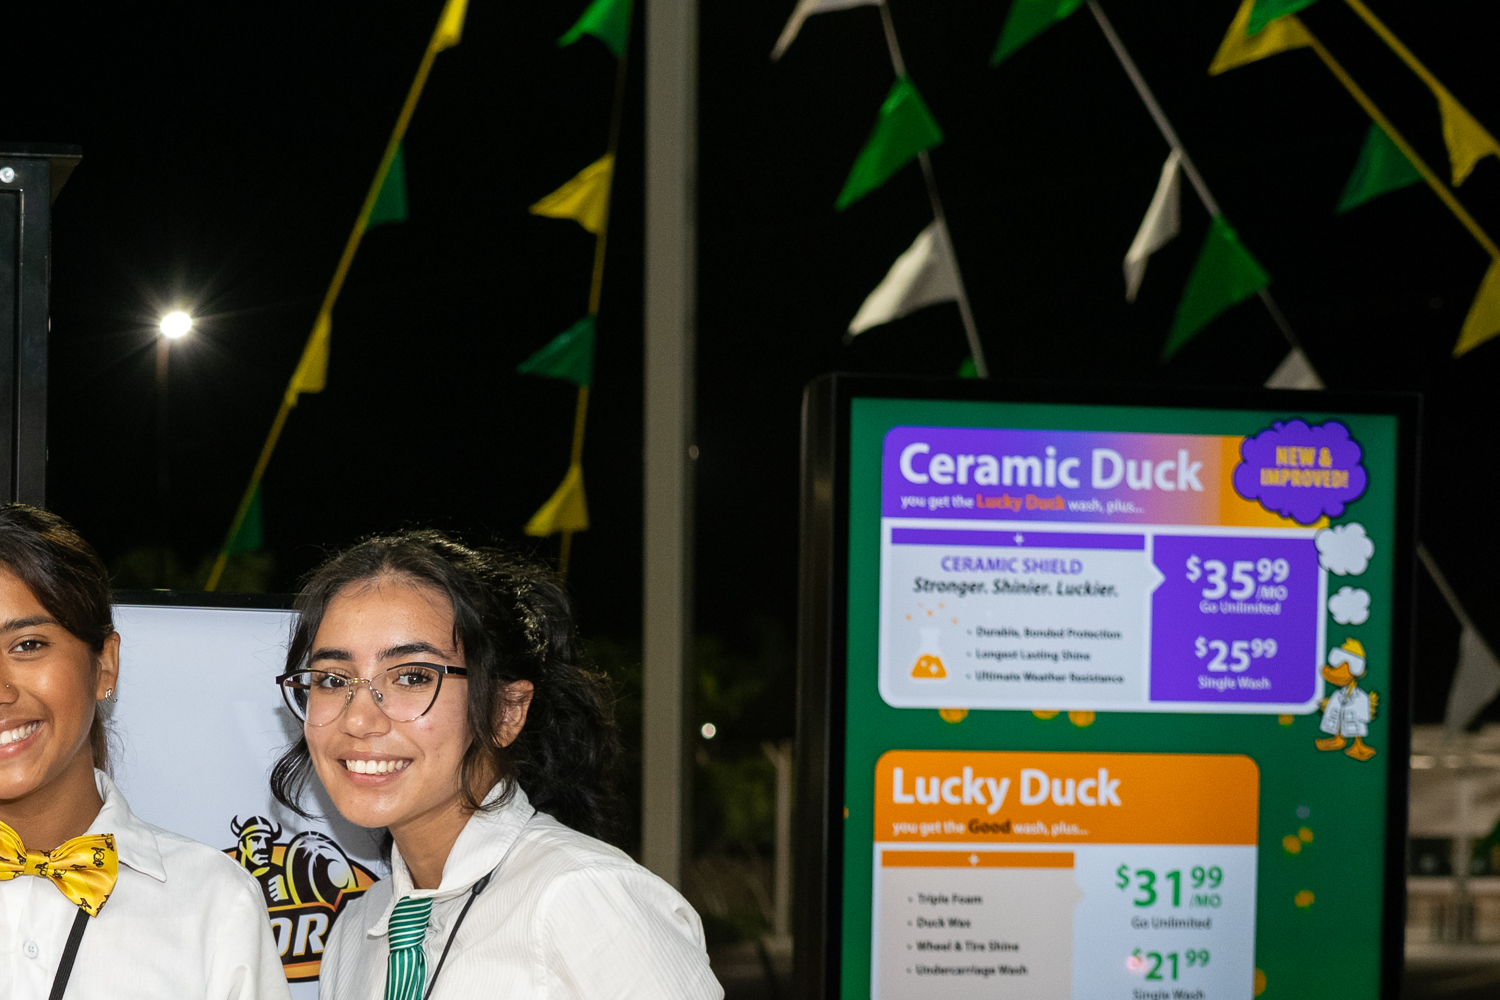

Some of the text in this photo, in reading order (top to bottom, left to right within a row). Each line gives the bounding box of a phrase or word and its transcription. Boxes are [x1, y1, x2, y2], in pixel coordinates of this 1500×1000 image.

[1276, 446, 1333, 467] NEW &
[899, 442, 1204, 492] Ceramic Duck
[1260, 468, 1349, 488] IMPROVED!
[900, 496, 926, 511] you
[927, 496, 950, 511] get
[952, 495, 975, 509] the
[976, 493, 1022, 512] Lucky
[1025, 494, 1066, 511] Duck
[941, 556, 1084, 575] CERAMIC SHIELD
[913, 576, 1118, 598] Stronger. Shinier. Luckier.
[1199, 601, 1281, 615] Go Unlimited
[1067, 628, 1122, 640] Protection
[975, 650, 1091, 663] Longest Lasting Shine
[975, 671, 1124, 684] Ultimate Weather Resistance
[1198, 675, 1272, 692] Single Wash
[892, 766, 1122, 815] Lucky Duck
[893, 822, 918, 836] you
[920, 822, 942, 837] get
[943, 820, 965, 833] the
[968, 819, 1011, 834] Good
[917, 893, 983, 906] Triple Foam
[916, 917, 946, 929] Duck
[1131, 915, 1213, 930] Go Unlimited
[916, 941, 952, 953] Wheel
[988, 941, 1020, 952] Shine
[915, 965, 1028, 978] Undercarriage Wash
